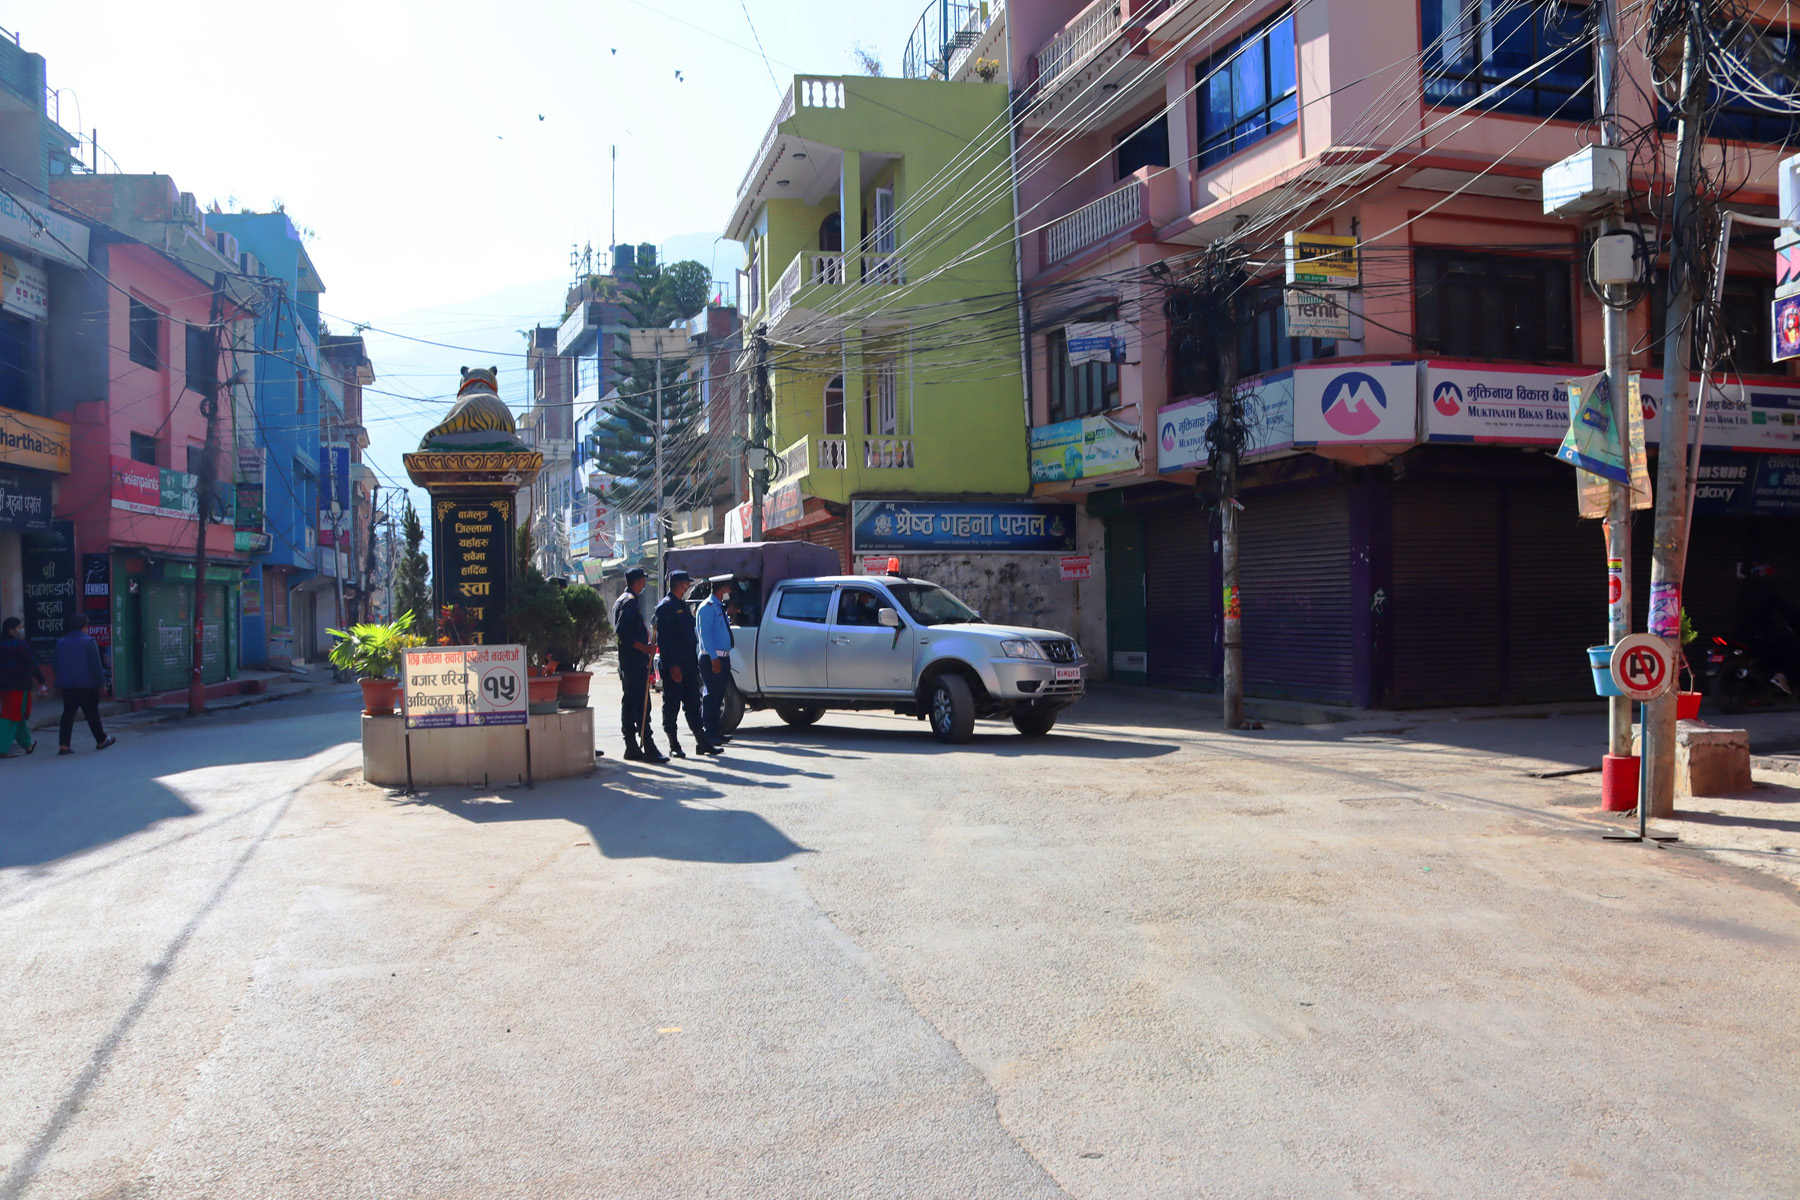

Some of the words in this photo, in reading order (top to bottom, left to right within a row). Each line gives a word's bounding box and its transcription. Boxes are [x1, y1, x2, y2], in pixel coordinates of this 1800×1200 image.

[1298, 302, 1339, 319] remit
[1466, 383, 1513, 401] मुक्तिनाथ
[1517, 385, 1549, 402] विकास
[1467, 406, 1516, 418] MUKTINATH
[1518, 408, 1543, 420] BIKAS
[1546, 410, 1569, 421] BANK
[1696, 485, 1735, 502] alaxy
[455, 522, 493, 534] जिल्लामा
[895, 507, 936, 536] श्रेष्ठ
[940, 513, 994, 537] गहना
[998, 514, 1047, 537] पसल
[42, 561, 56, 579] श्री
[459, 581, 492, 598] स्वा
[37, 601, 63, 618] गहना
[37, 618, 64, 633] पसल
[411, 673, 438, 687] बजार
[441, 669, 469, 686] एरिया
[483, 675, 515, 702] १५
[457, 690, 476, 706] गति
